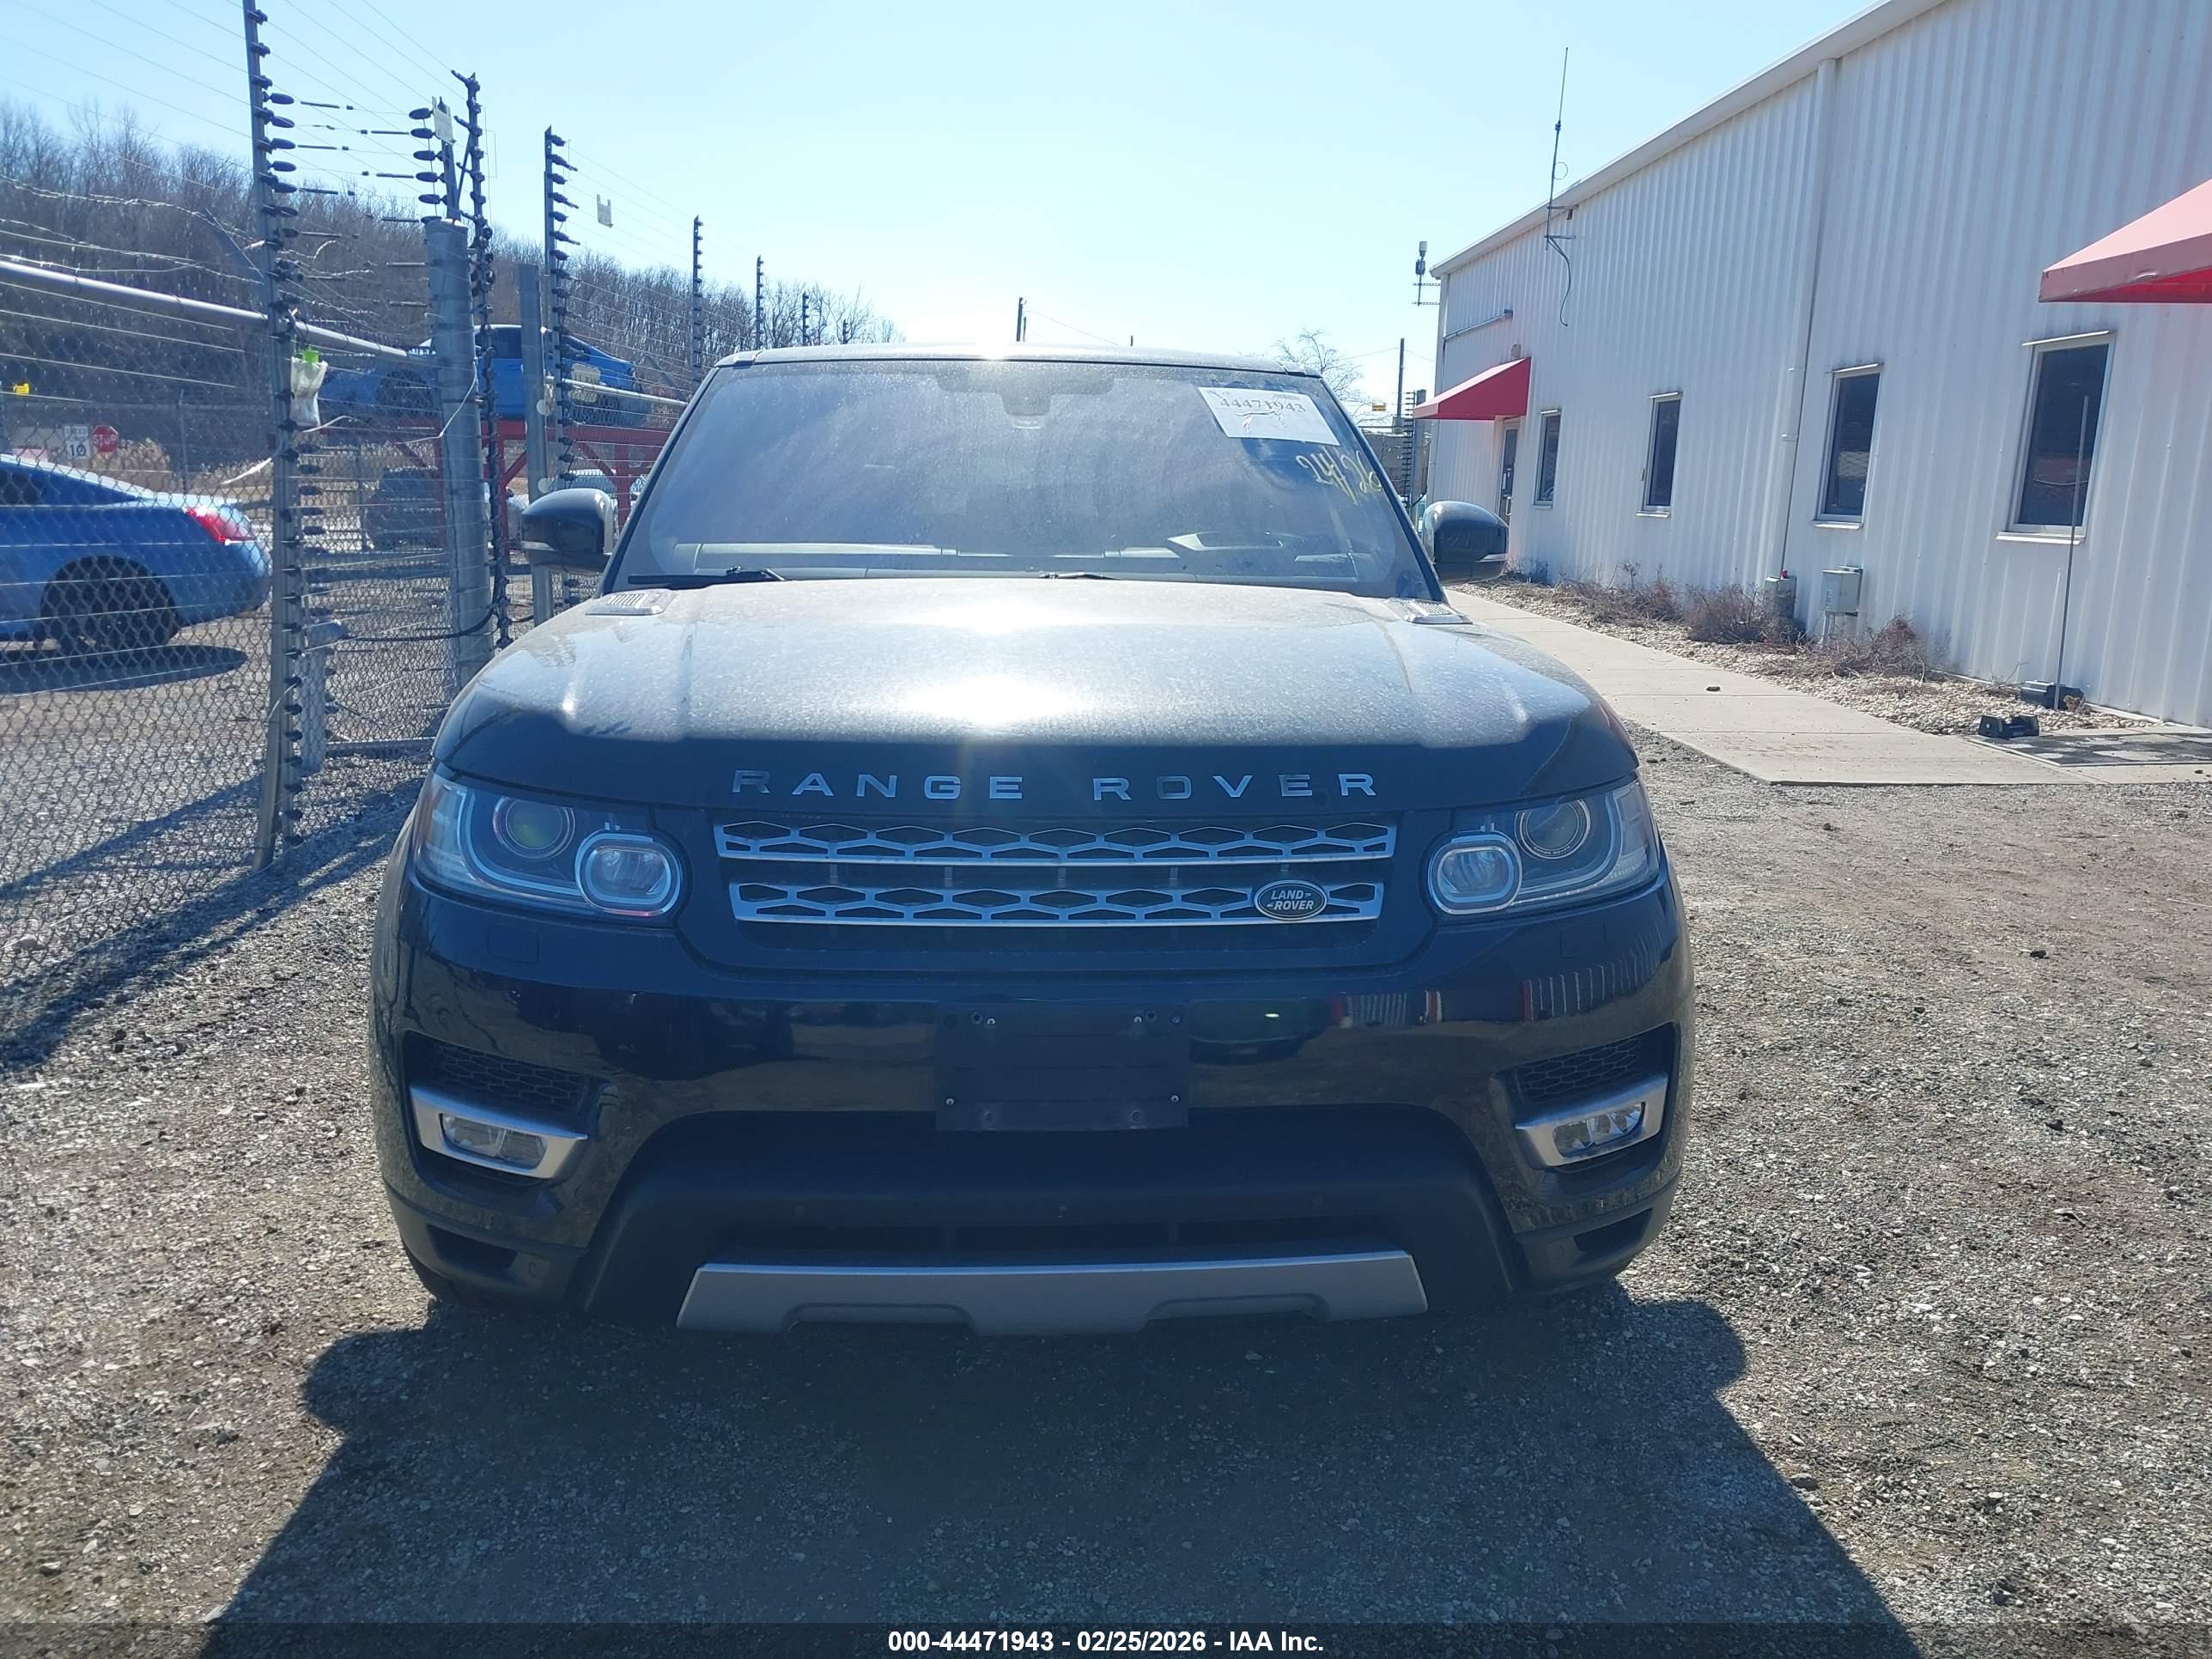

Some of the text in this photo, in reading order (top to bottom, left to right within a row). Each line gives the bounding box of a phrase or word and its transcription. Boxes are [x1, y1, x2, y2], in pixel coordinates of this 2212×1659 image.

[93, 434, 117, 447] STOP
[69, 443, 87, 457] 10
[732, 769, 1377, 801] RANGE ROVER
[1271, 890, 1304, 900] LAND
[1273, 900, 1314, 910] ROVER
